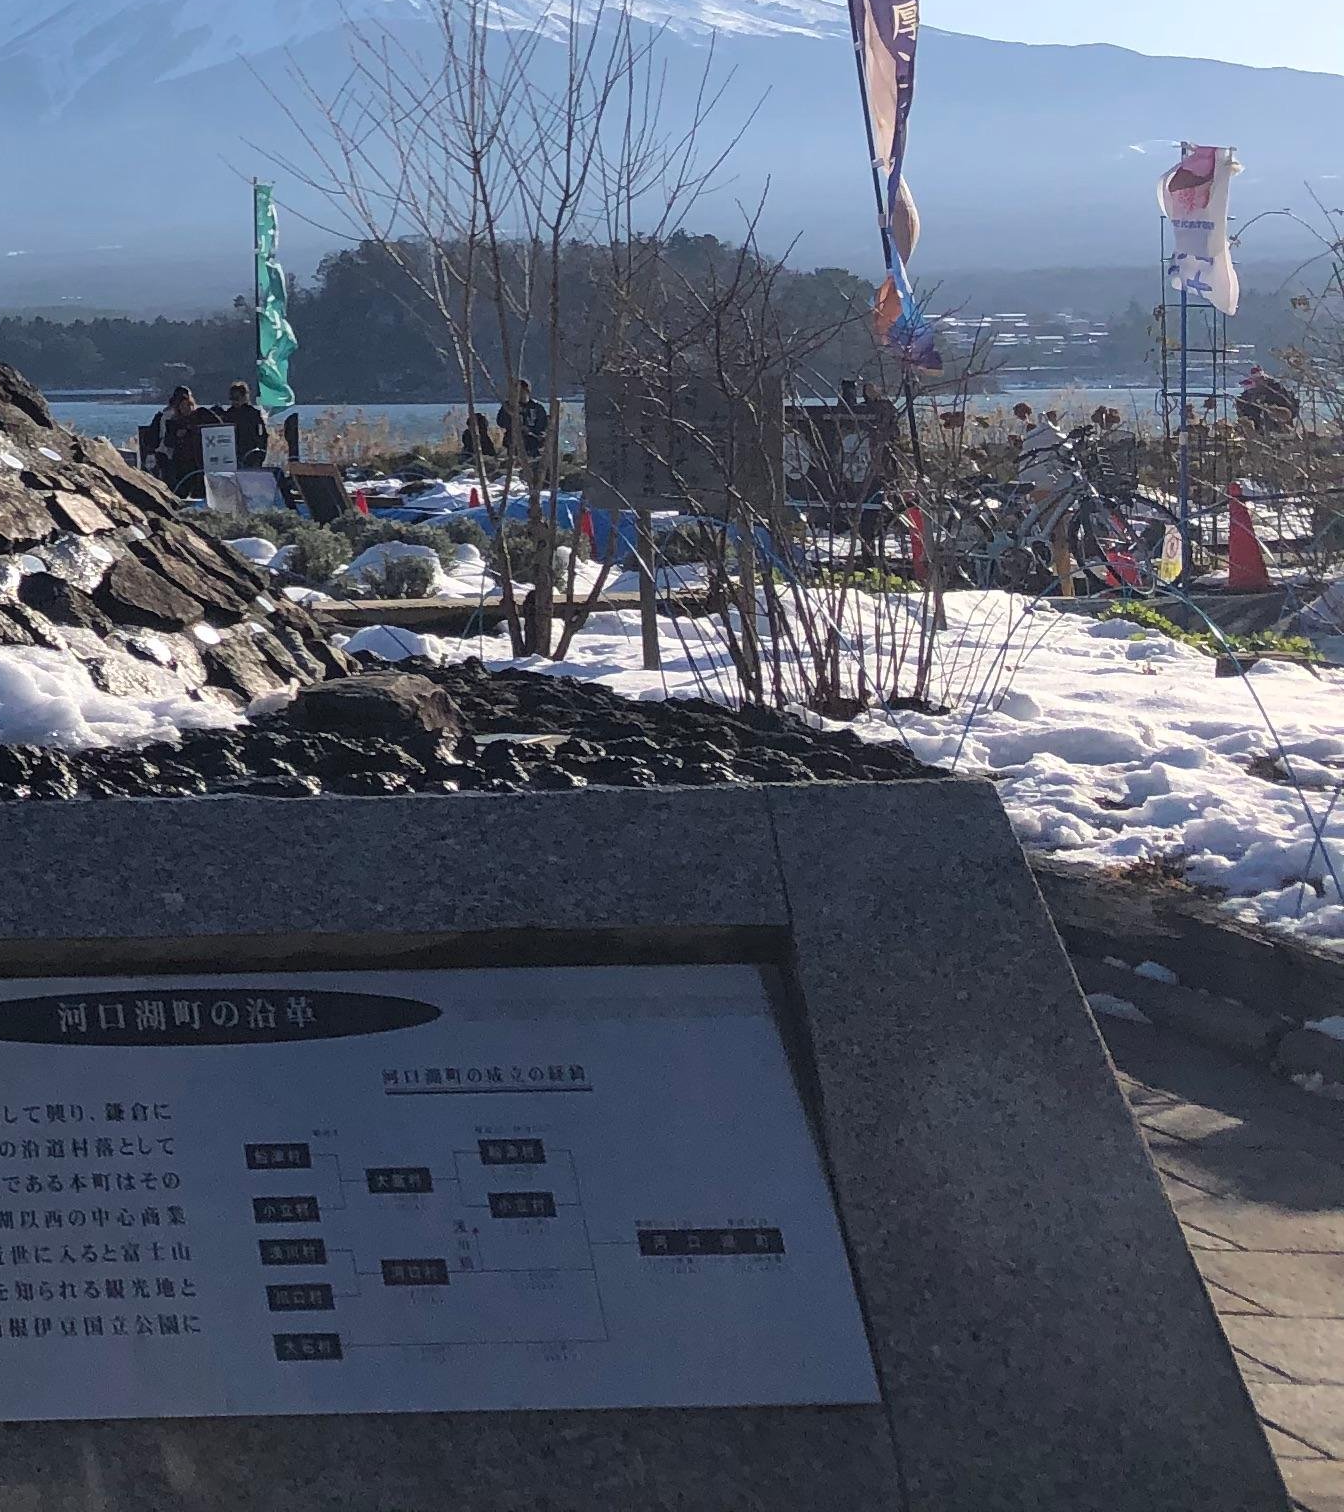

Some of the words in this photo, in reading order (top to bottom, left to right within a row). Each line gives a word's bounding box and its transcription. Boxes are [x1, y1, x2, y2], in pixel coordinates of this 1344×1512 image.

[57, 996, 318, 1032] 河口湖町の沿革
